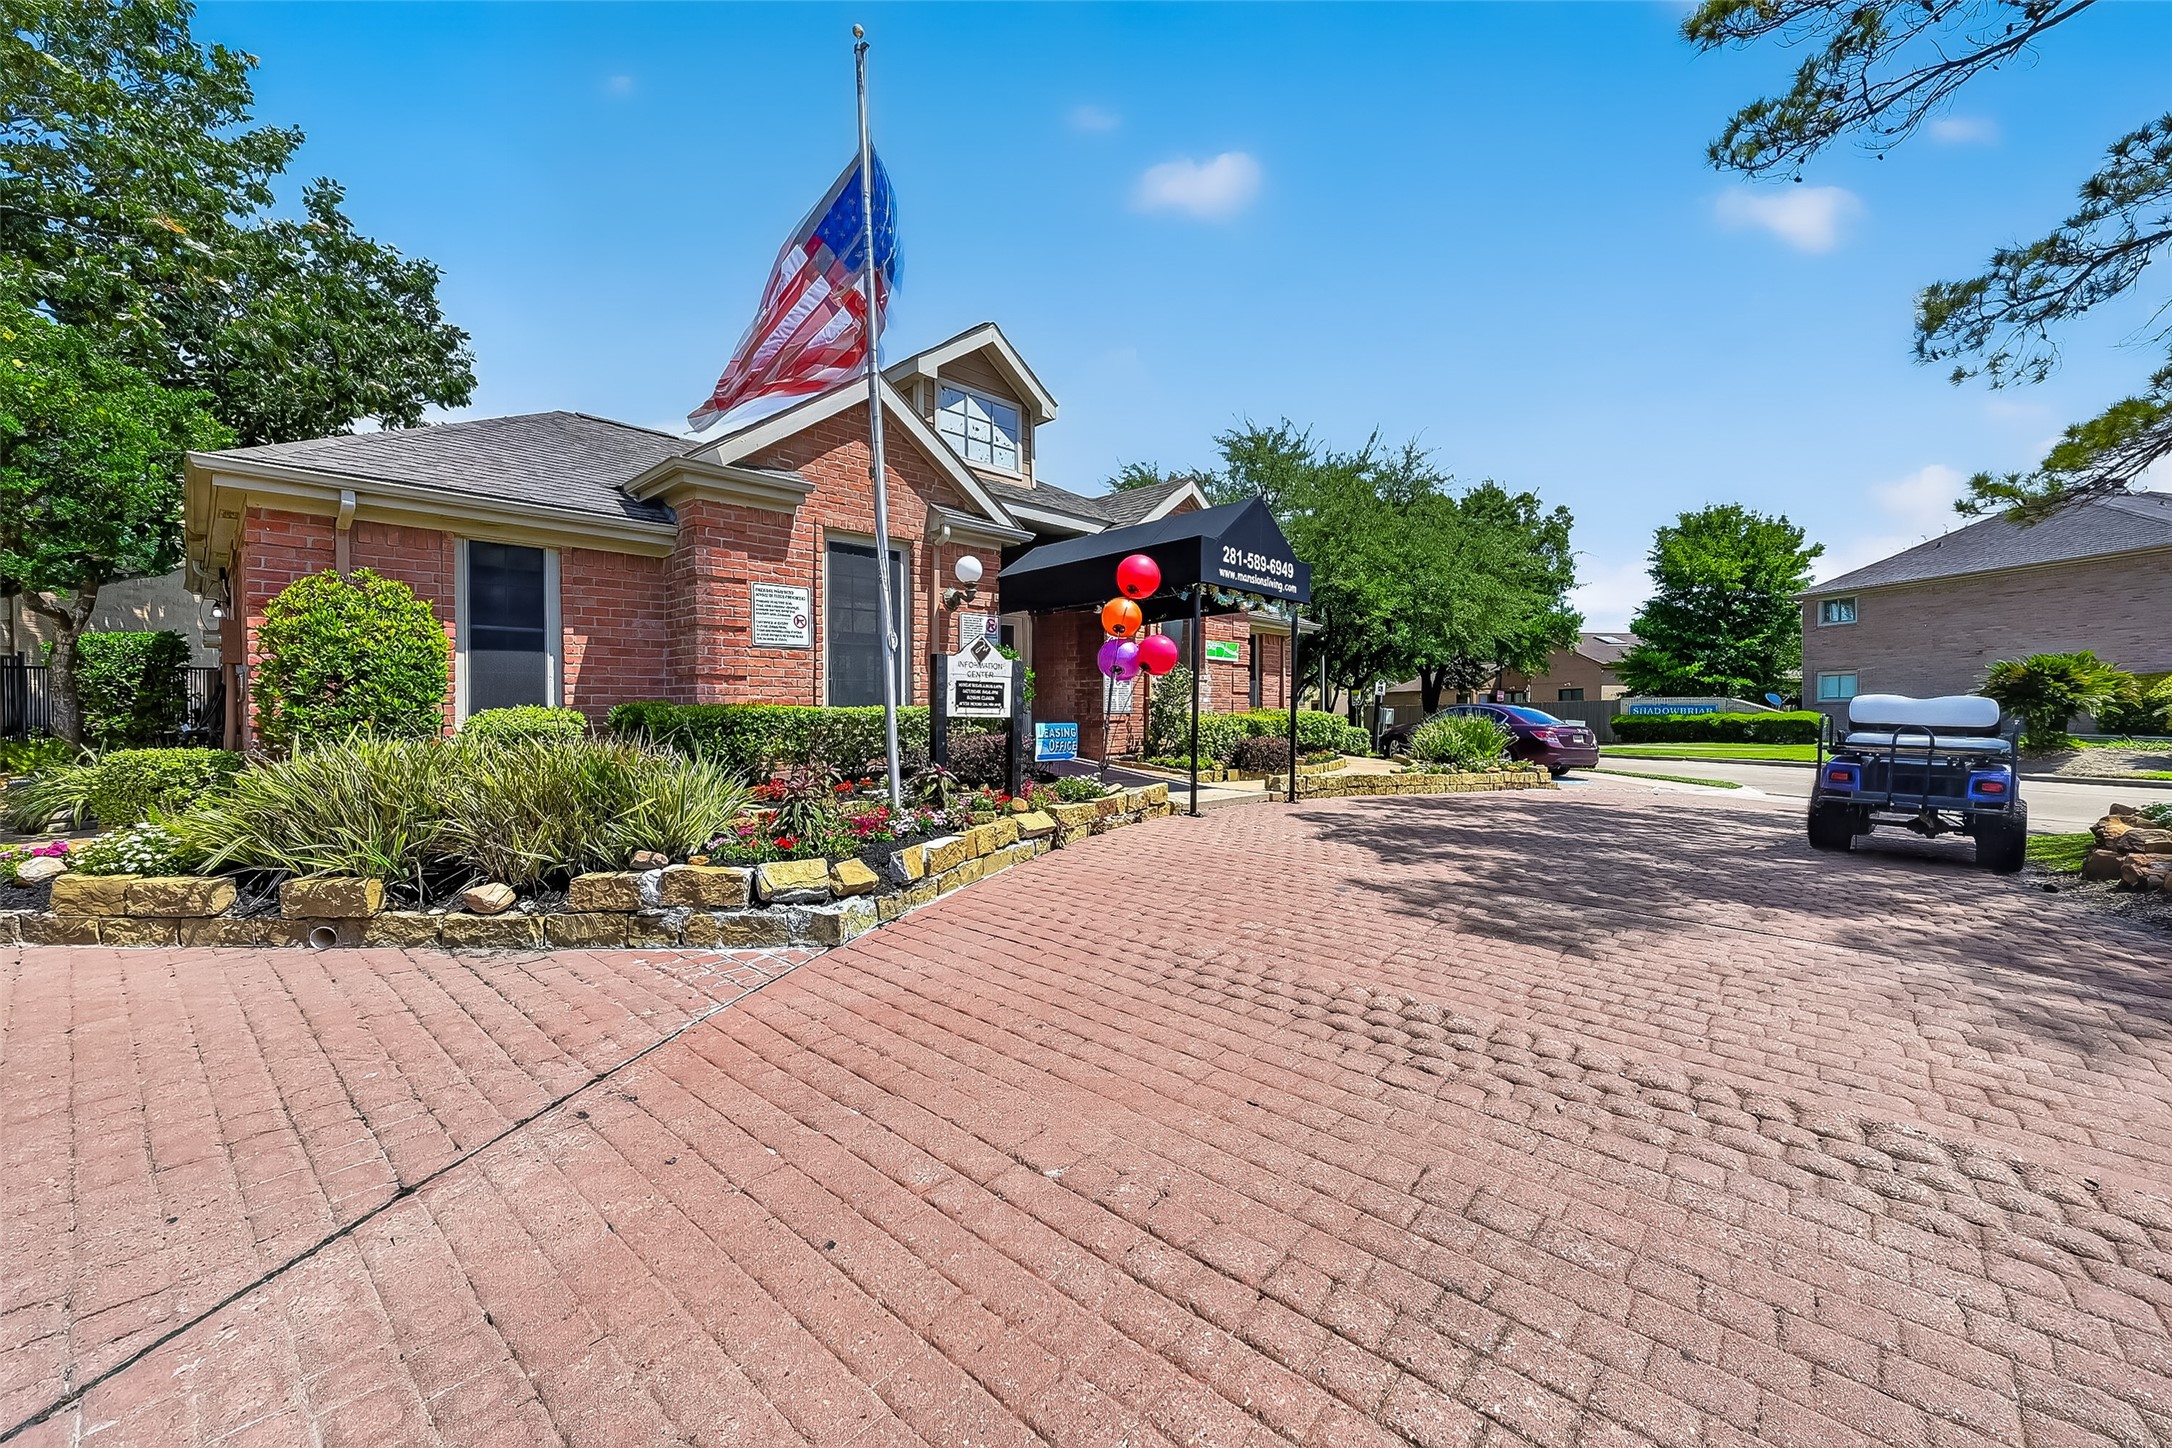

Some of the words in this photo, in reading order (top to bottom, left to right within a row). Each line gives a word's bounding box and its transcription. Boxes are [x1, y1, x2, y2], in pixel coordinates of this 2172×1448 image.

[1222, 545, 1294, 579] 281-589-6949
[1218, 568, 1298, 594] www.mansionsliving.com
[957, 660, 1003, 670] INFORMATION
[966, 670, 995, 679] CENTER
[1632, 706, 1713, 715] SHADOWBRIAR
[1038, 725, 1077, 738] LEASING
[1049, 739, 1078, 752] OFFICE
